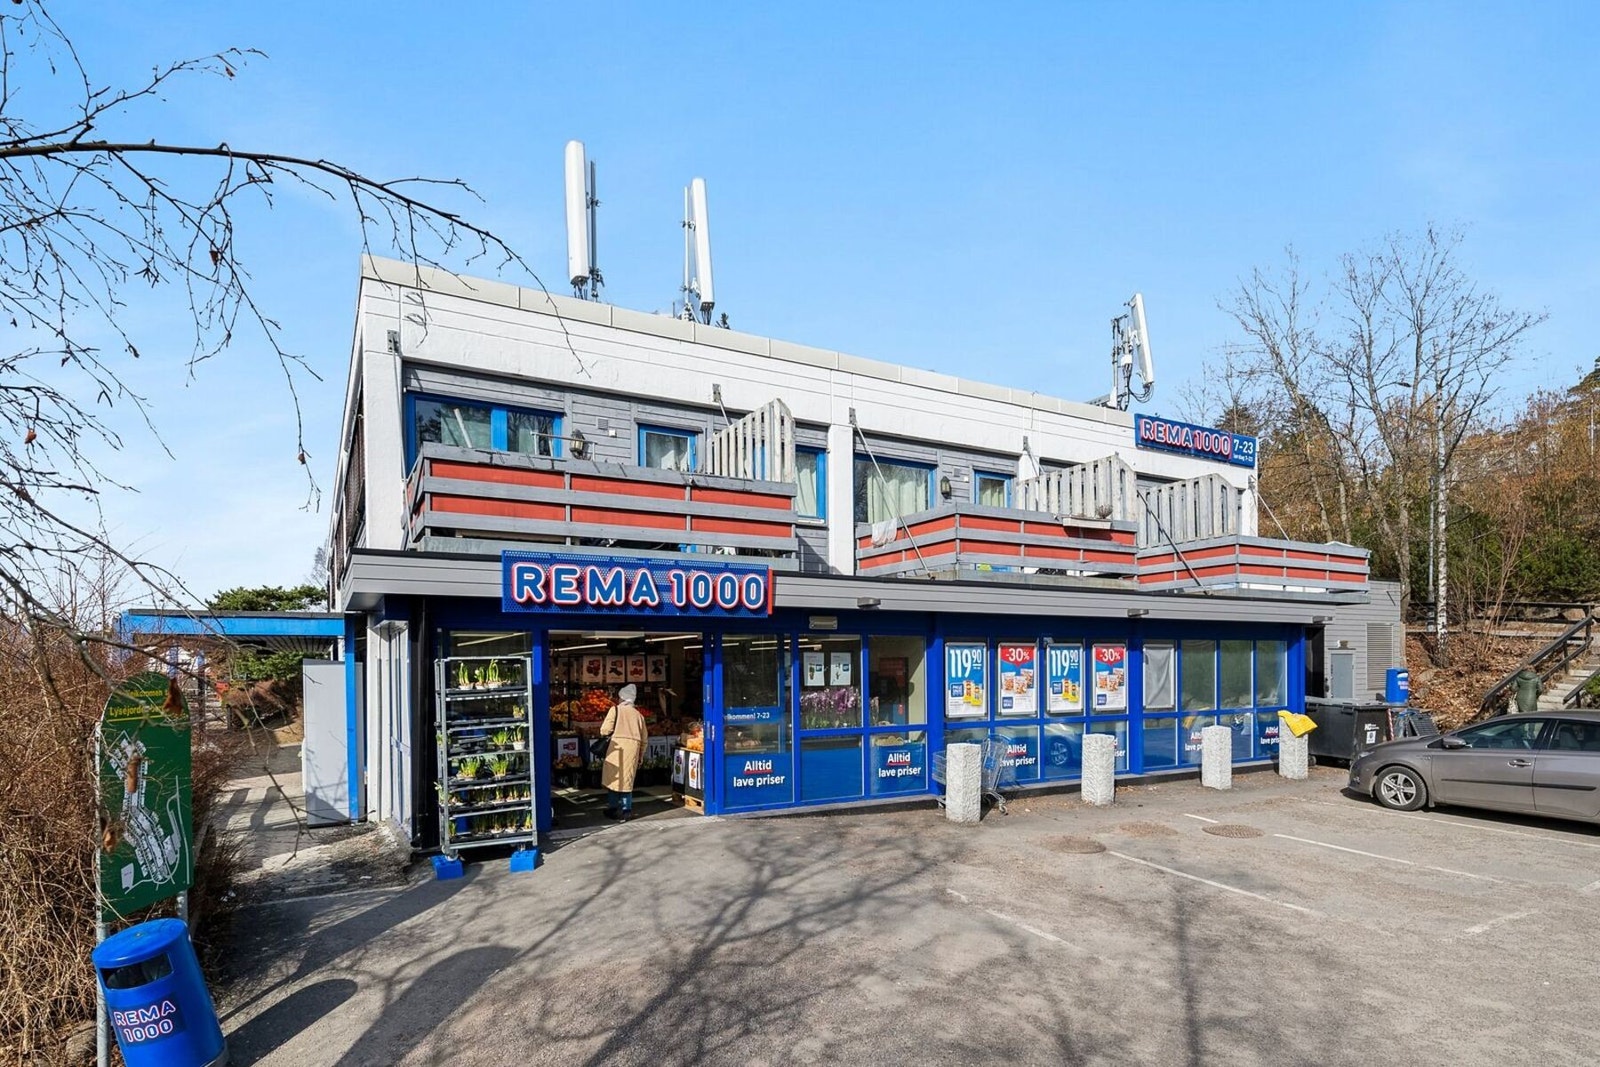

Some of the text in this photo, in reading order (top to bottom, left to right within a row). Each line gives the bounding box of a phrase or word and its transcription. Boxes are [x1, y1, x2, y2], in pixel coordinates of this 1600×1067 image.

[1141, 418, 1230, 455] REMA 1000
[1233, 439, 1254, 454] 7-23
[511, 562, 765, 609] REMA 1000
[1006, 648, 1029, 661] -30%
[1100, 649, 1120, 661] -30%
[950, 648, 971, 678] 119
[1051, 650, 1069, 676] 119
[1260, 737, 1271, 745] lave
[1007, 744, 1027, 754] Alltid
[887, 752, 911, 763] Alltid
[1015, 756, 1036, 767] priser
[744, 760, 772, 771] Alltid
[878, 766, 921, 778] lave priser
[733, 775, 786, 787] lave priser
[113, 1000, 176, 1026] REMA
[123, 1019, 174, 1043] 1000
